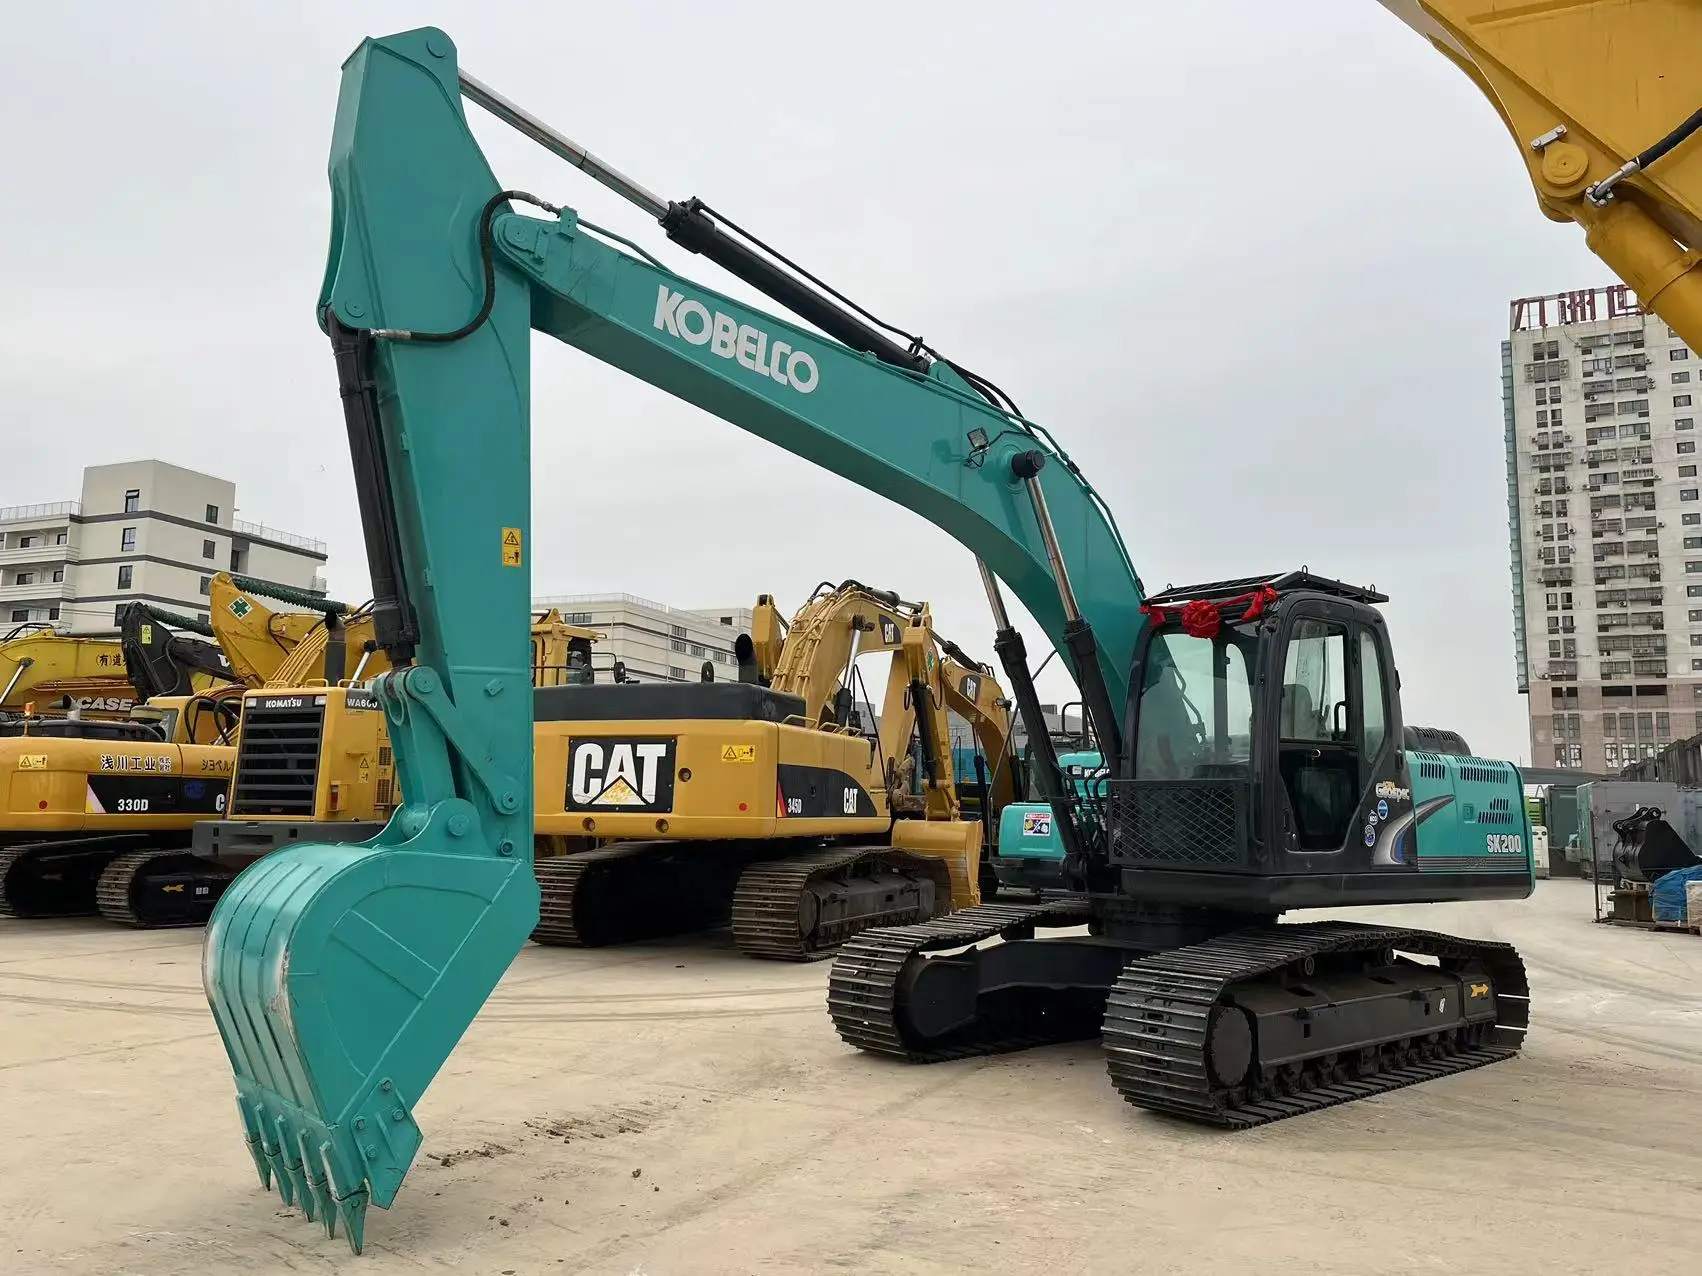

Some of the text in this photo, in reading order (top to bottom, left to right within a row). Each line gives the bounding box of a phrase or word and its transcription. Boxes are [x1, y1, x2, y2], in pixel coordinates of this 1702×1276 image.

[653, 284, 819, 394] KOBELCO
[884, 623, 895, 643] CAT
[77, 696, 134, 711] CASE
[265, 697, 302, 708] KOMATSU
[572, 743, 667, 805] CAT
[117, 798, 149, 811] 330D
[787, 798, 802, 814] 345D
[843, 787, 858, 814] CAT
[1486, 834, 1522, 853] SK200
